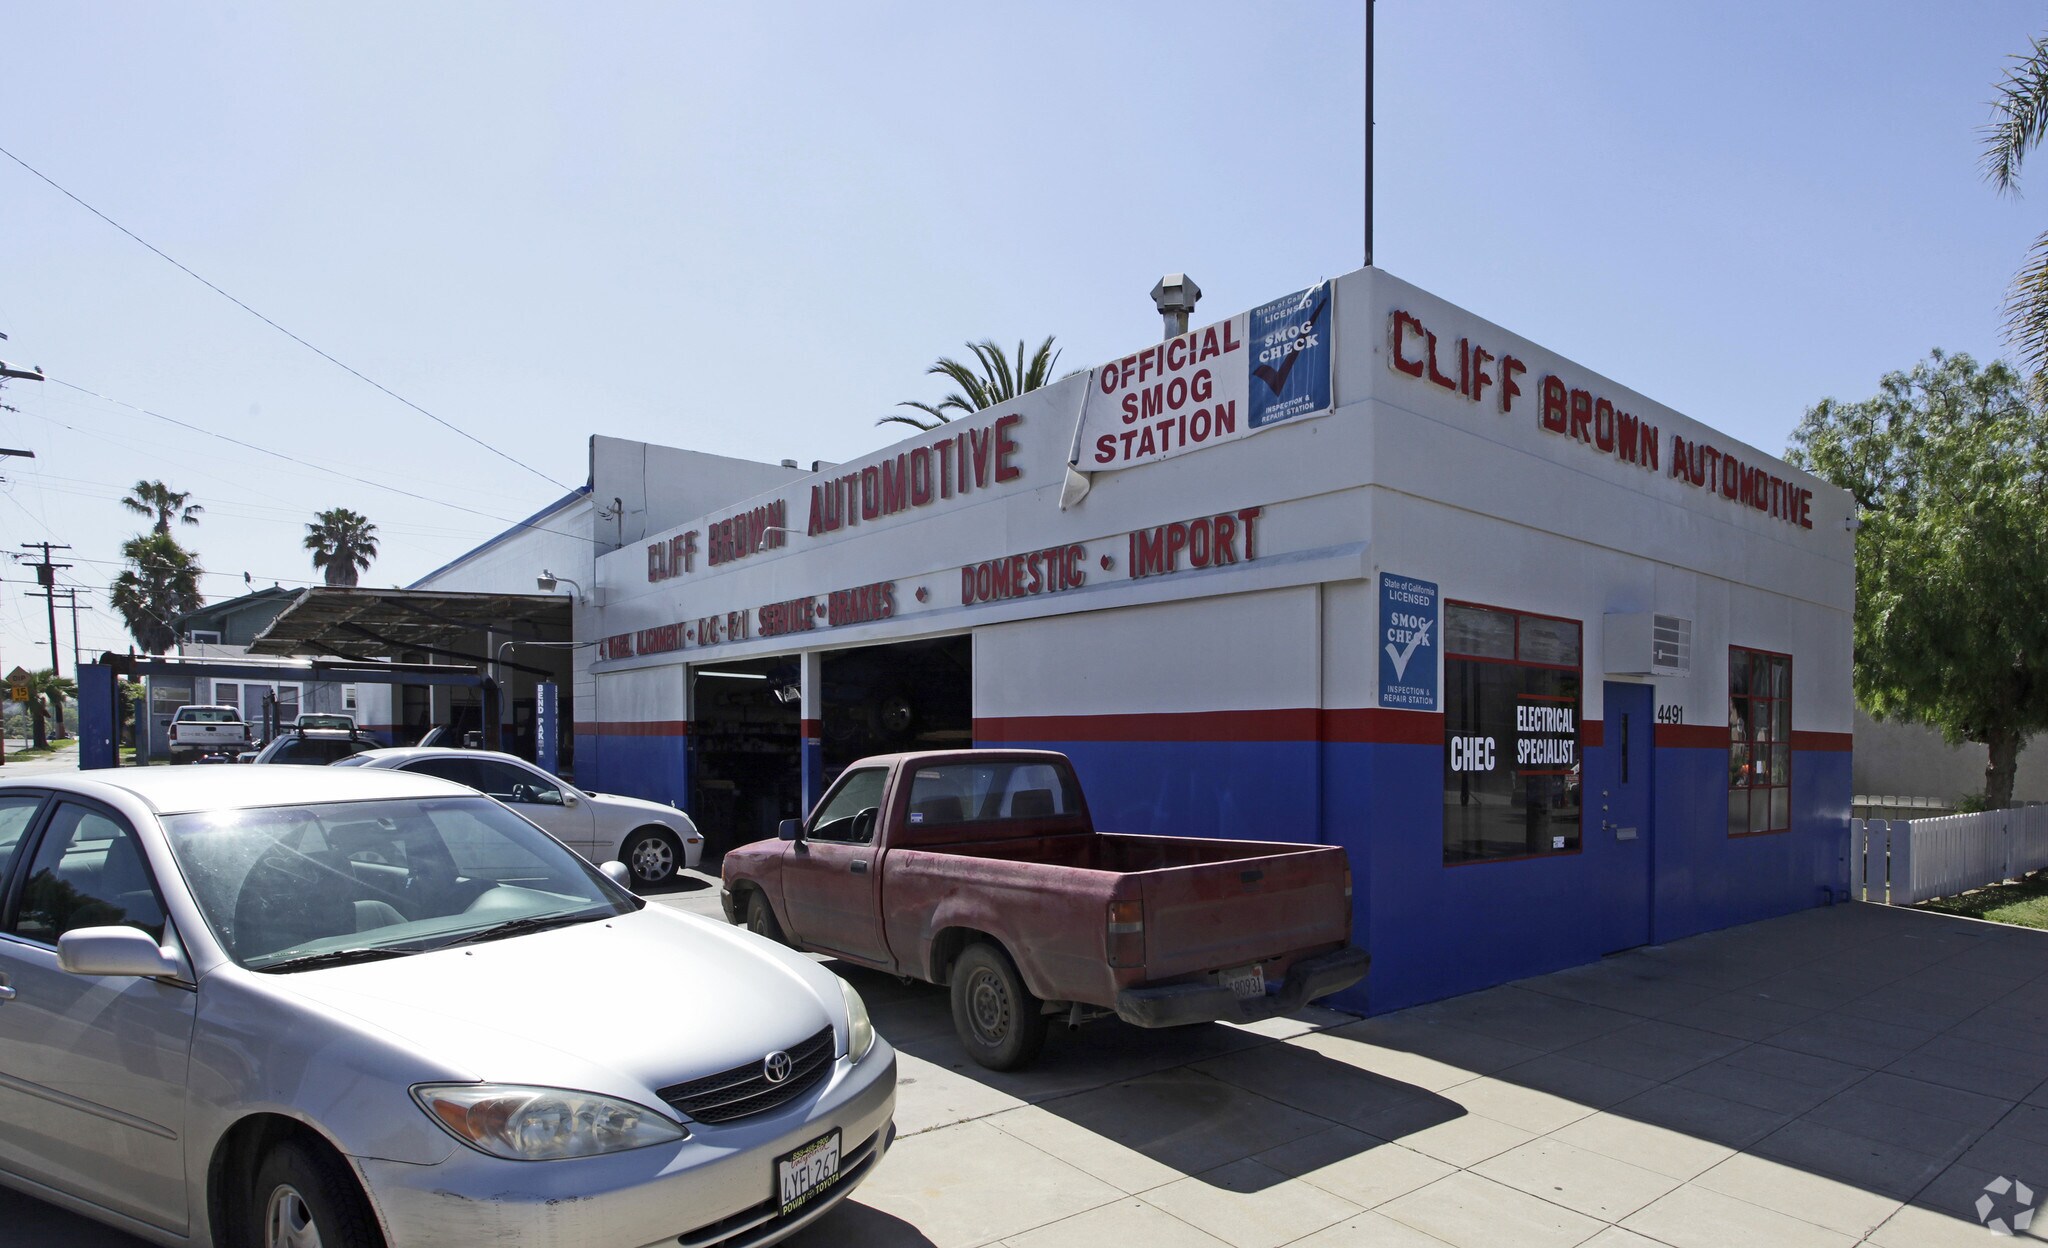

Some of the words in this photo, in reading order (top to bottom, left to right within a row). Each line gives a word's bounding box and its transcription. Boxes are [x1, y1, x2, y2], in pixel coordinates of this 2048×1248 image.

[1256, 305, 1276, 316] State
[1287, 287, 1323, 304] Califnia
[1265, 299, 1313, 324] LICENSED
[1258, 333, 1319, 363] CHECK
[1264, 320, 1313, 348] SMOG
[1100, 320, 1240, 394] OFFICIAL
[1121, 368, 1213, 425] SMOG
[1265, 397, 1303, 414] INSPECTION
[1261, 411, 1284, 423] REPAIR
[1286, 401, 1314, 415] STATION
[1389, 309, 1527, 413] CLIFF
[1539, 374, 1658, 471] BROWN
[1671, 434, 1813, 530] AUTOMOTIVE
[1094, 400, 1236, 463] STATION
[647, 529, 699, 583] CLIFF
[708, 498, 786, 567] BROWN
[807, 413, 1023, 537] AUTOMOTIVE
[608, 632, 634, 659] WHEEL
[636, 621, 686, 656] ALIGNMENT
[758, 594, 815, 637] SERVICE
[828, 580, 895, 627] BRAKES
[961, 544, 1086, 606] DOMESTIC
[1129, 506, 1263, 579] IMPORT
[1384, 577, 1400, 589] State
[1401, 582, 1408, 590] of
[1408, 582, 1435, 597] California
[1389, 589, 1430, 606] LICENSED
[1391, 612, 1427, 630] SMOG
[16, 688, 27, 696] 15
[1384, 693, 1407, 703] REPAIR
[1408, 695, 1433, 705] STATION
[1387, 685, 1424, 696] INSPECTION
[1516, 705, 1574, 733] ELECTRICAL
[1658, 704, 1683, 724] 4491
[1450, 735, 1495, 771] CHEC
[1516, 738, 1574, 764] SPECIALIST
[1227, 977, 1263, 998] 80931
[784, 1149, 837, 1202] 4YFL267
[783, 1193, 807, 1216] POWAY
[815, 1172, 839, 1194] TOYOTA
